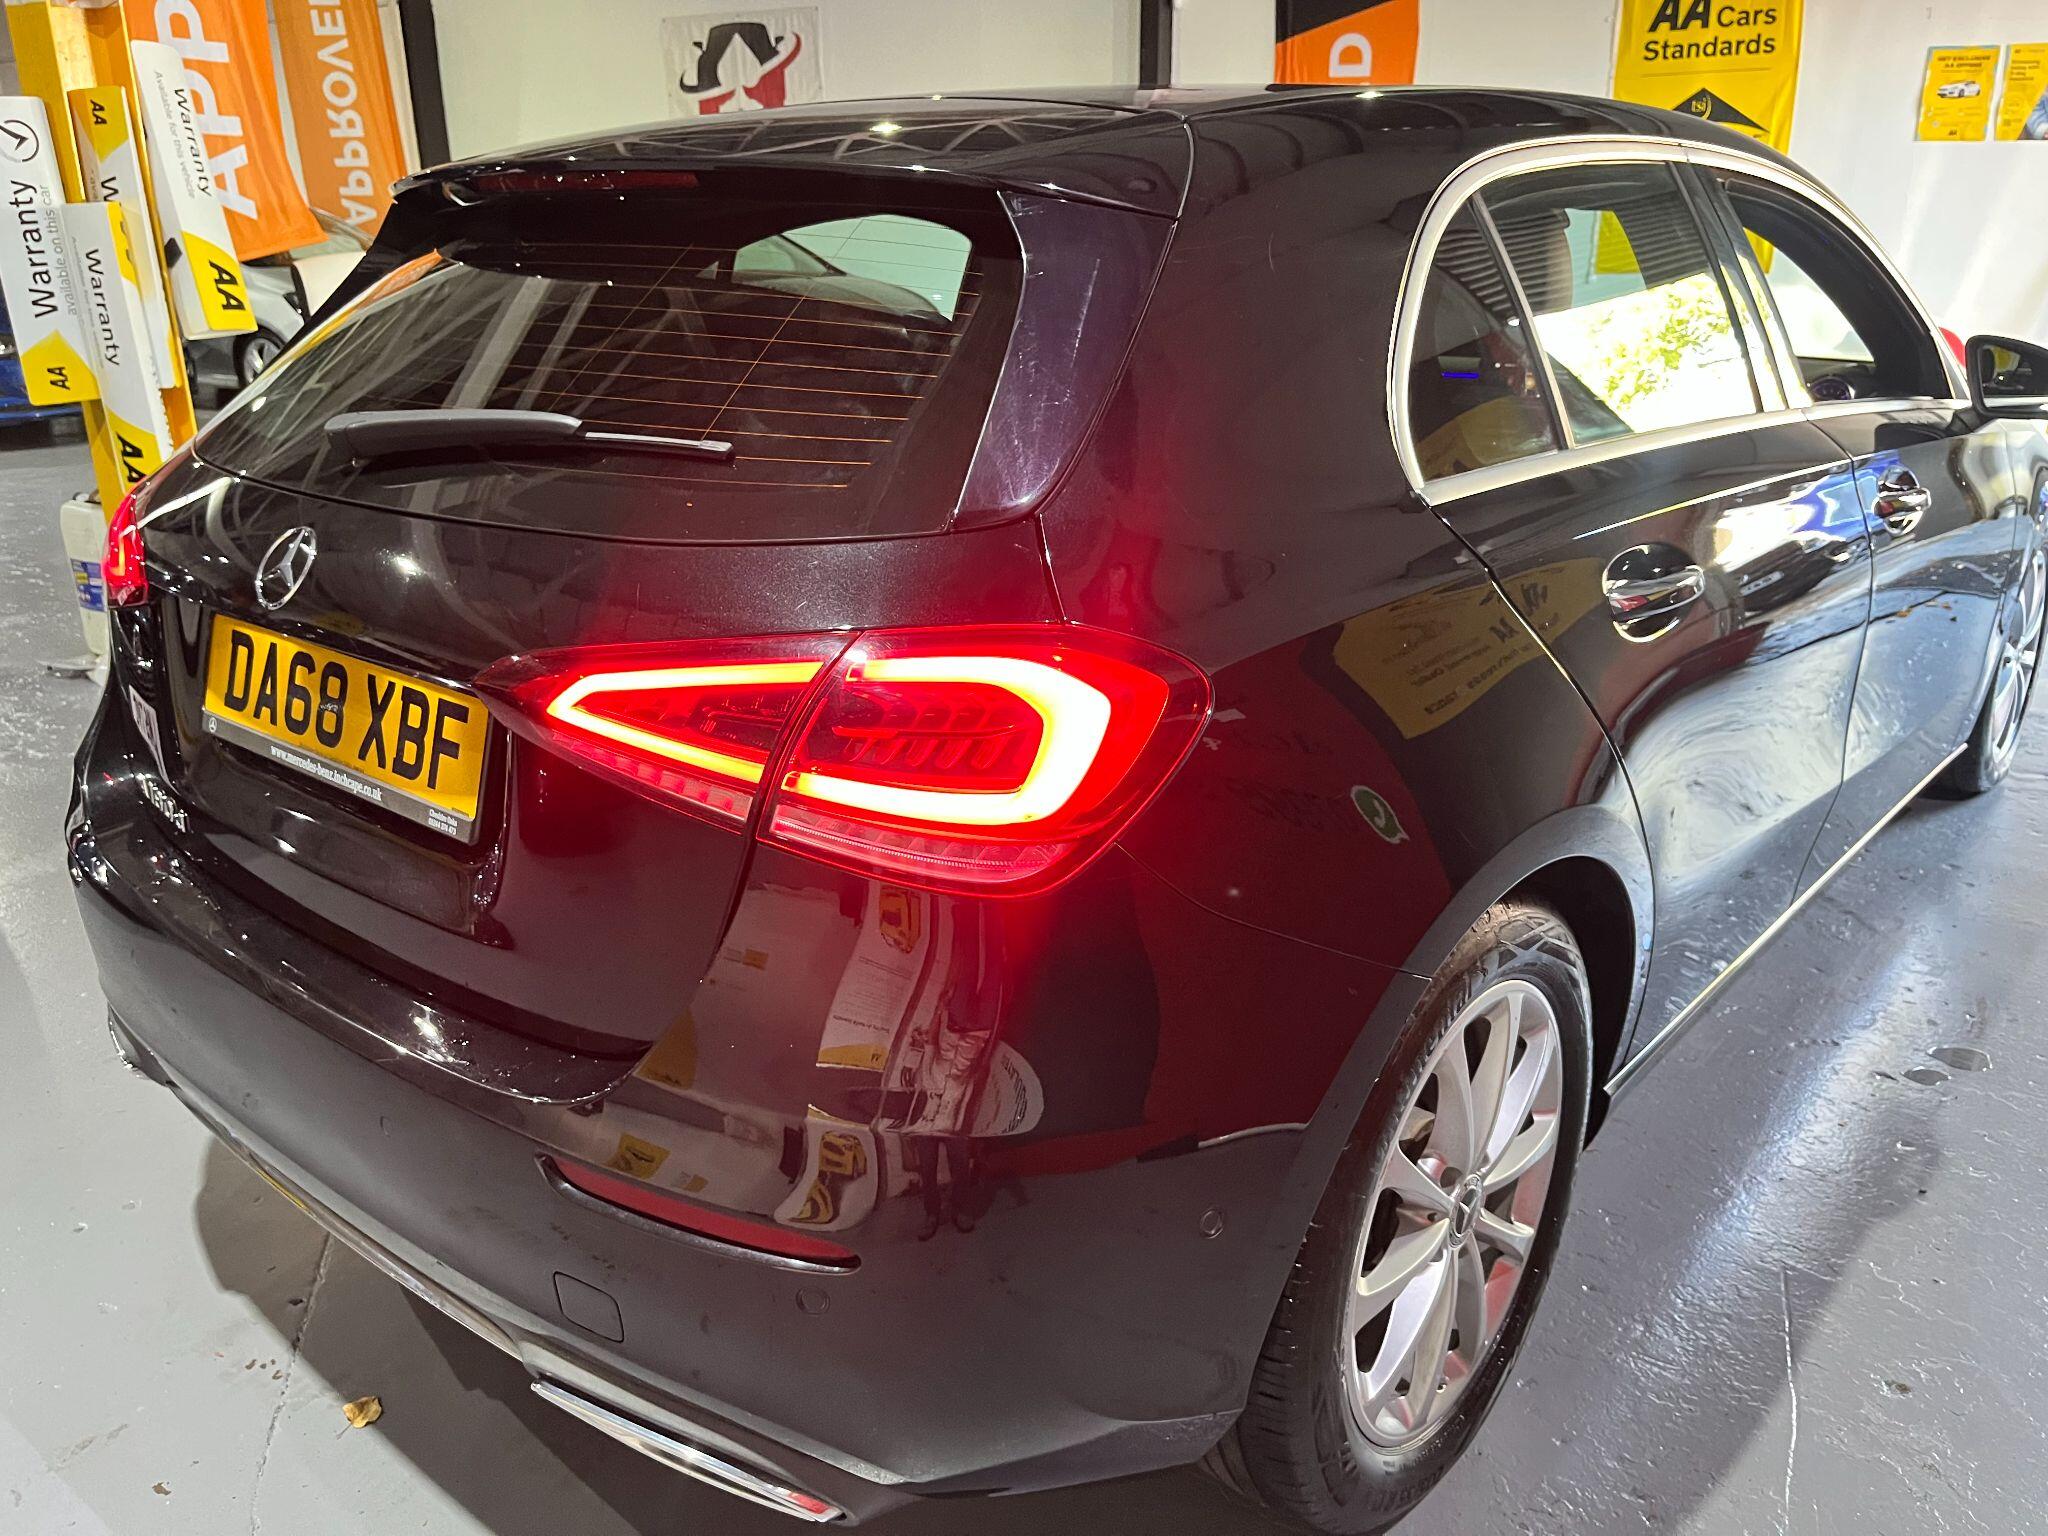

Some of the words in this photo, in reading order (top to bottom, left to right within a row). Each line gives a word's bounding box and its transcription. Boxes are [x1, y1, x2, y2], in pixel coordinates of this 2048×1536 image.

[1648, 0, 1711, 33] AA
[1717, 6, 1778, 28] Cars
[1643, 33, 1777, 62] Standards
[90, 99, 108, 126] AA
[174, 87, 213, 198] Warranty
[39, 183, 54, 207] car
[44, 208, 60, 235] this
[50, 236, 64, 255] on
[9, 180, 59, 319] Warranty
[54, 256, 78, 315] available
[85, 247, 120, 367] Warranty
[208, 258, 247, 312] AA
[46, 366, 71, 391] AA
[116, 431, 147, 483] AA
[223, 628, 349, 749] DA68
[357, 672, 470, 790] XBF
[270, 745, 383, 801] www.mercedes-benz.inchcape.co.uk
